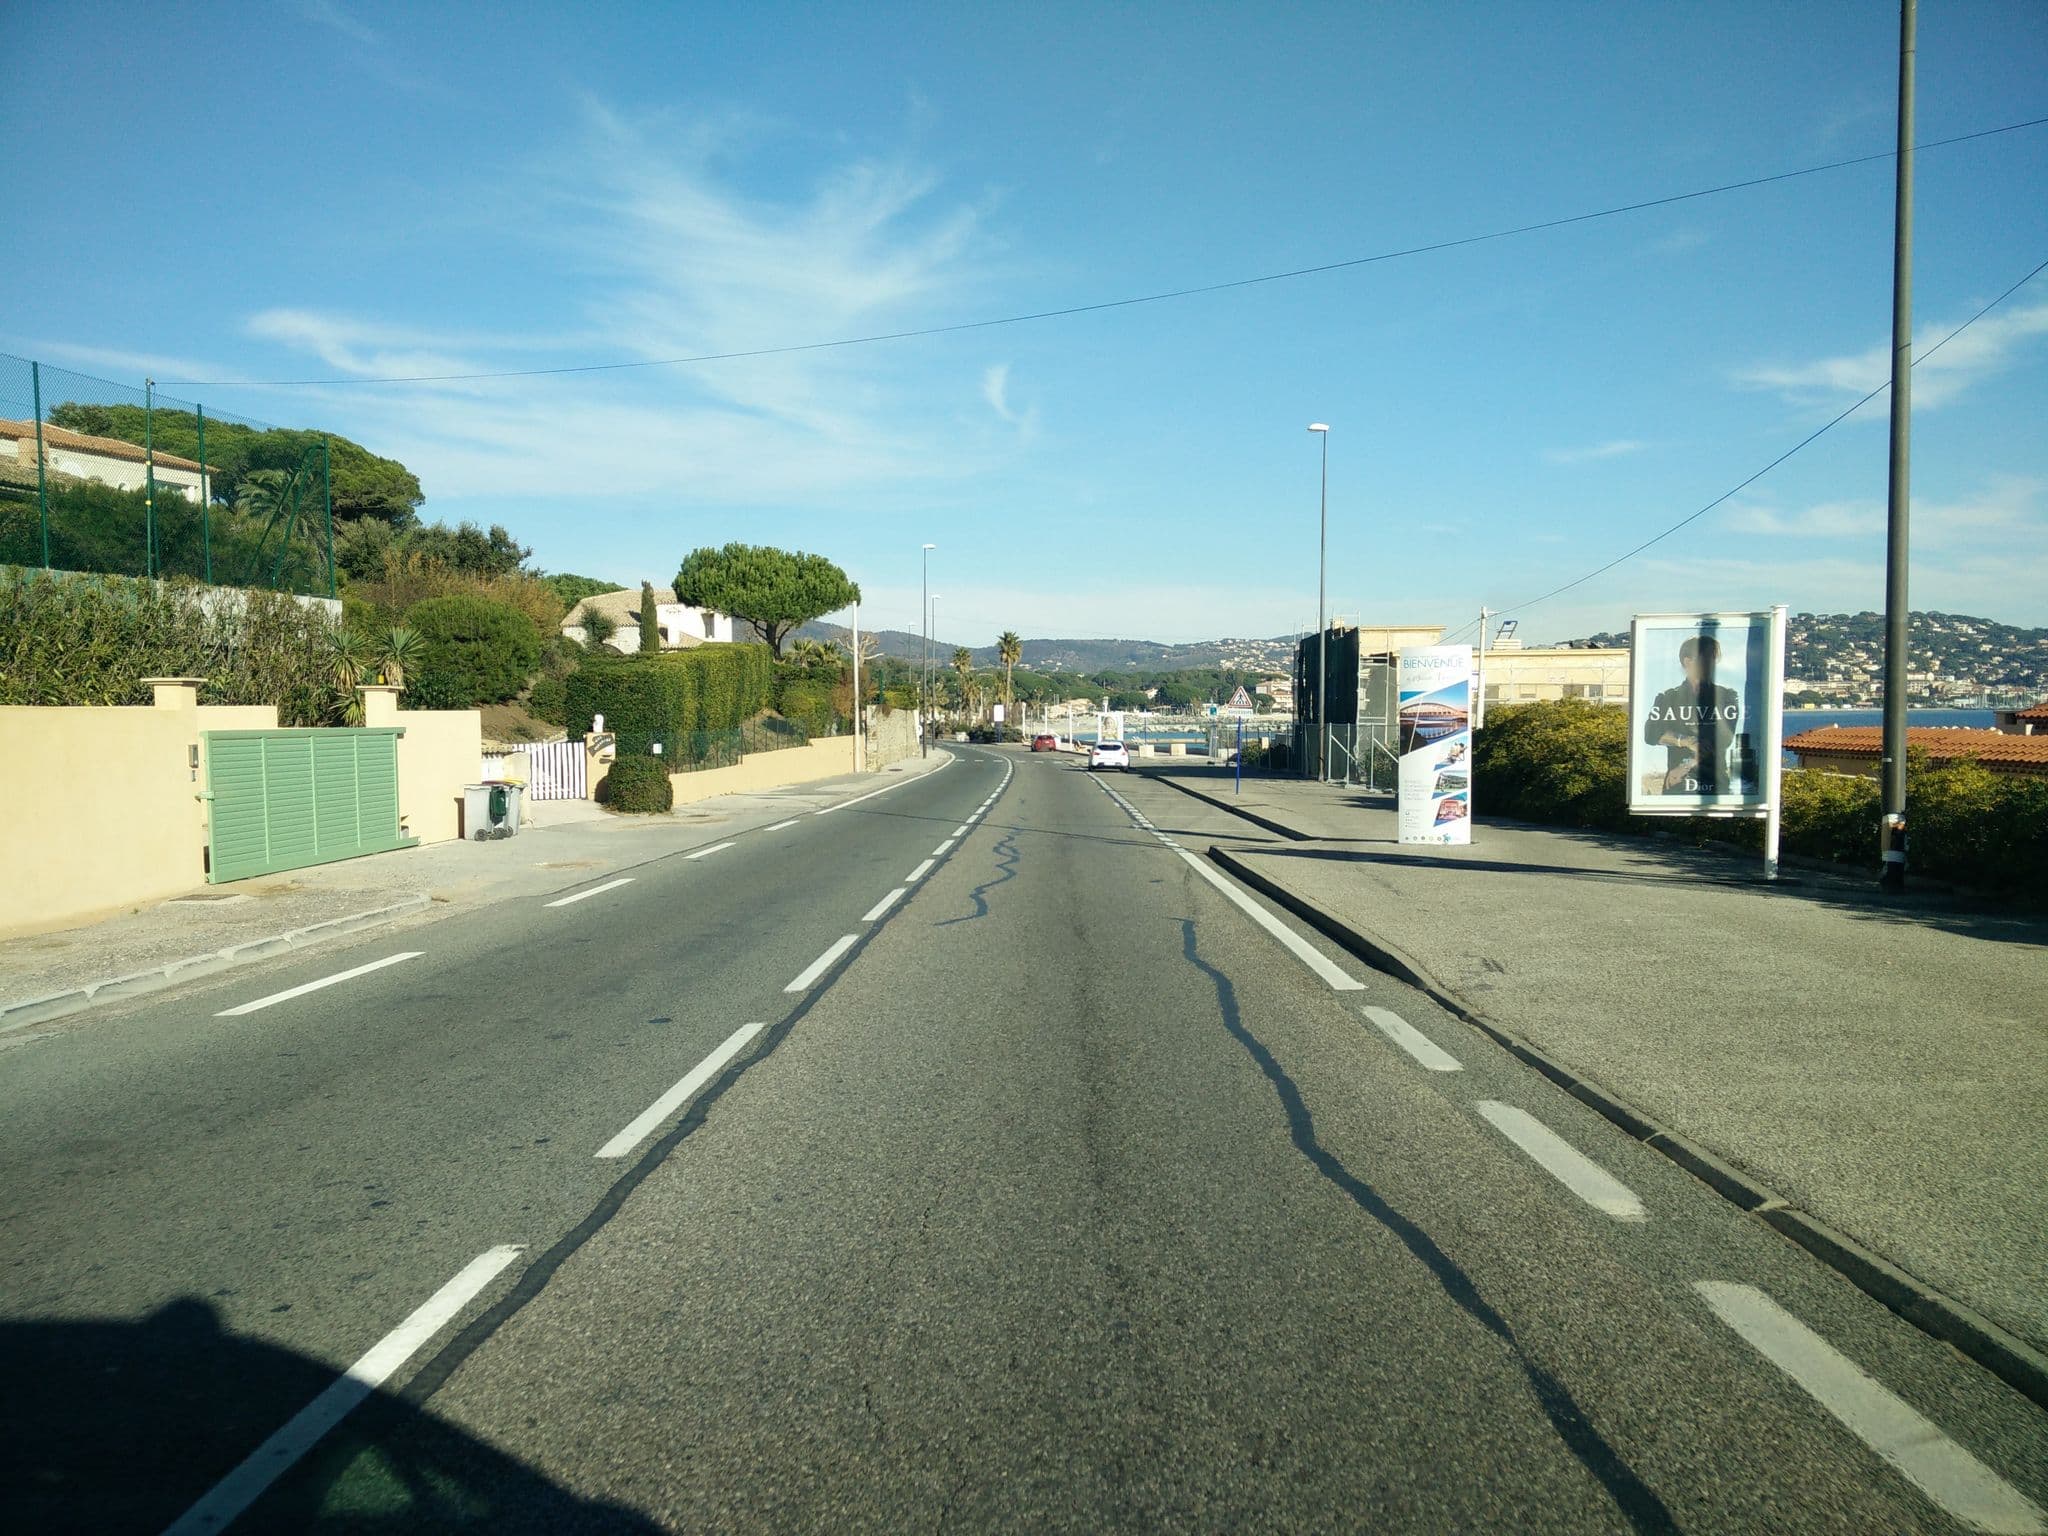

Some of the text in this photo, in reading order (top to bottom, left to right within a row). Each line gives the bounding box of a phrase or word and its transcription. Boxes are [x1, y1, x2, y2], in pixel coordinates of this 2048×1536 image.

[1403, 656, 1464, 669] BIENVENUE
[1650, 704, 1752, 721] SAUVAGE
[1685, 778, 1715, 792] Dior
